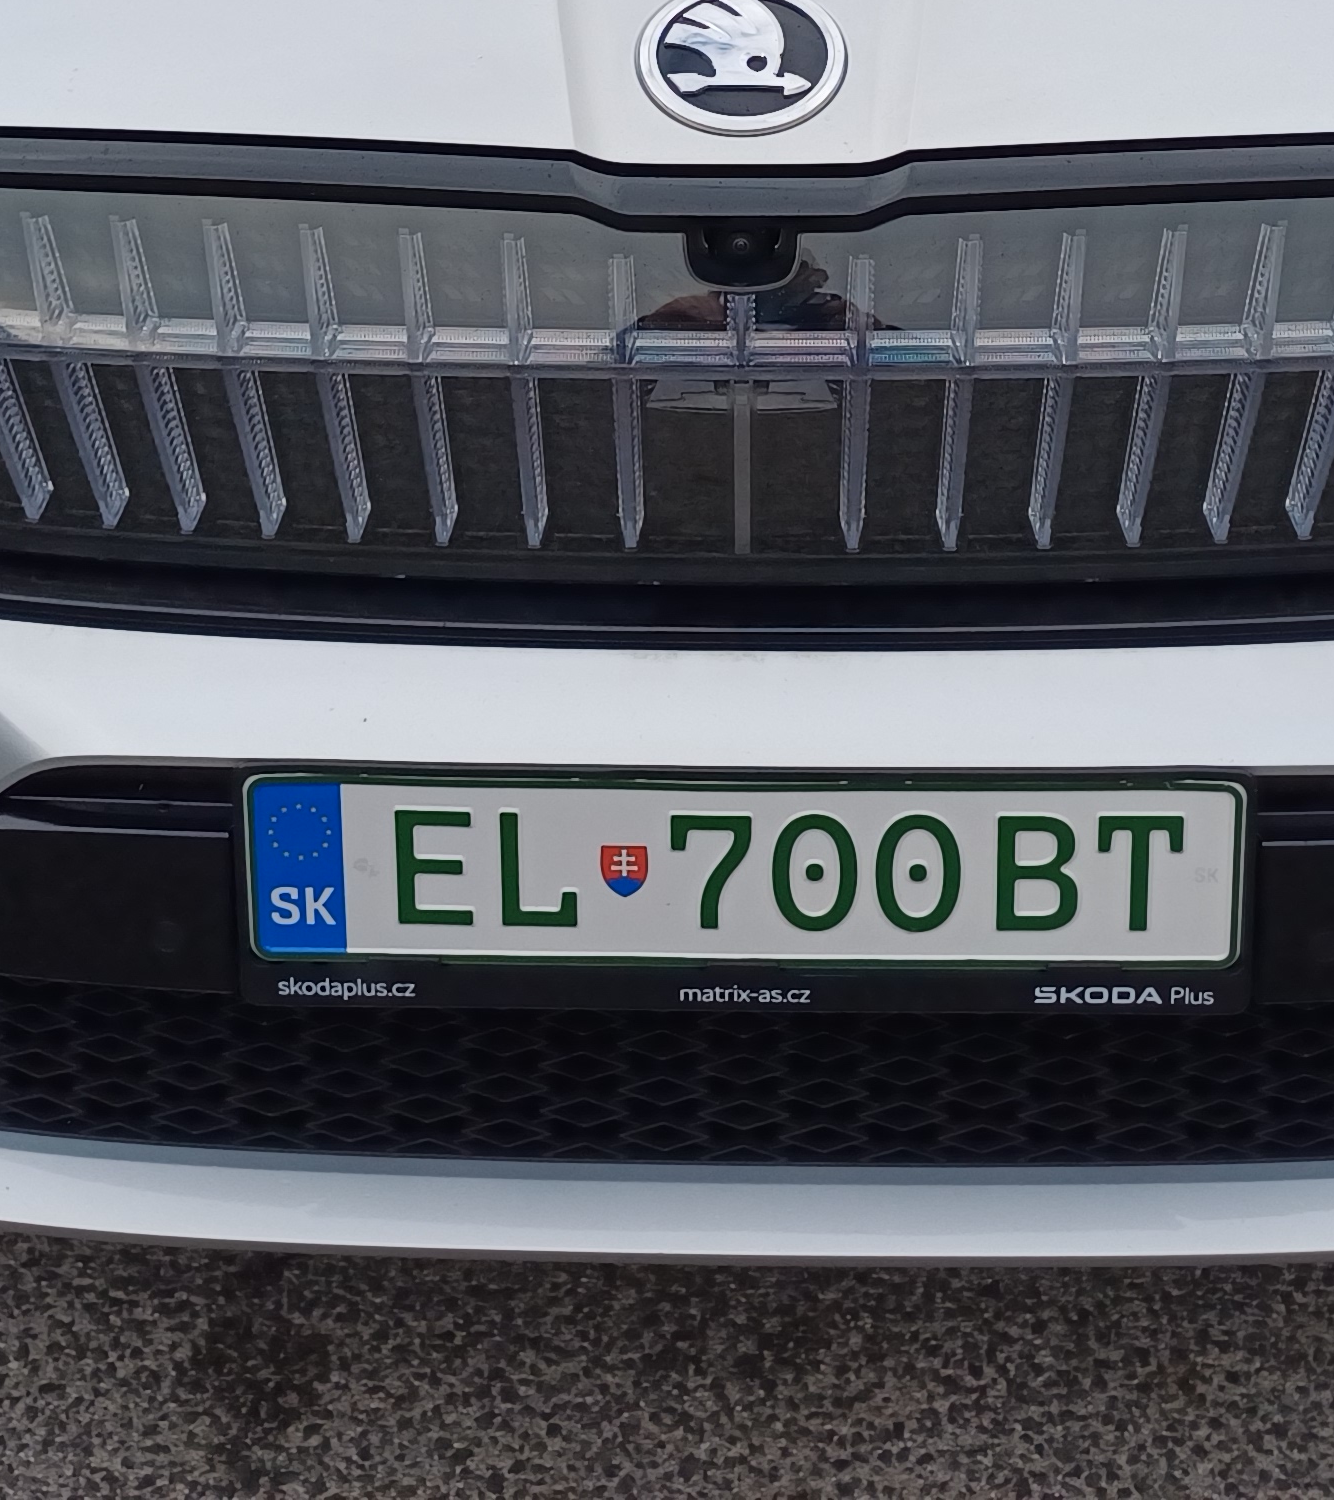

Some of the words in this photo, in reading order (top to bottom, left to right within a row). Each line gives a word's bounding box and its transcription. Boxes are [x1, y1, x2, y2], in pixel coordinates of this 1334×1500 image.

[394, 809, 578, 927] EL
[270, 887, 337, 926] SK
[277, 976, 416, 1001] skodaplus.cz
[679, 984, 811, 1003] matrix-as.cz
[1170, 986, 1215, 1005] Plus
